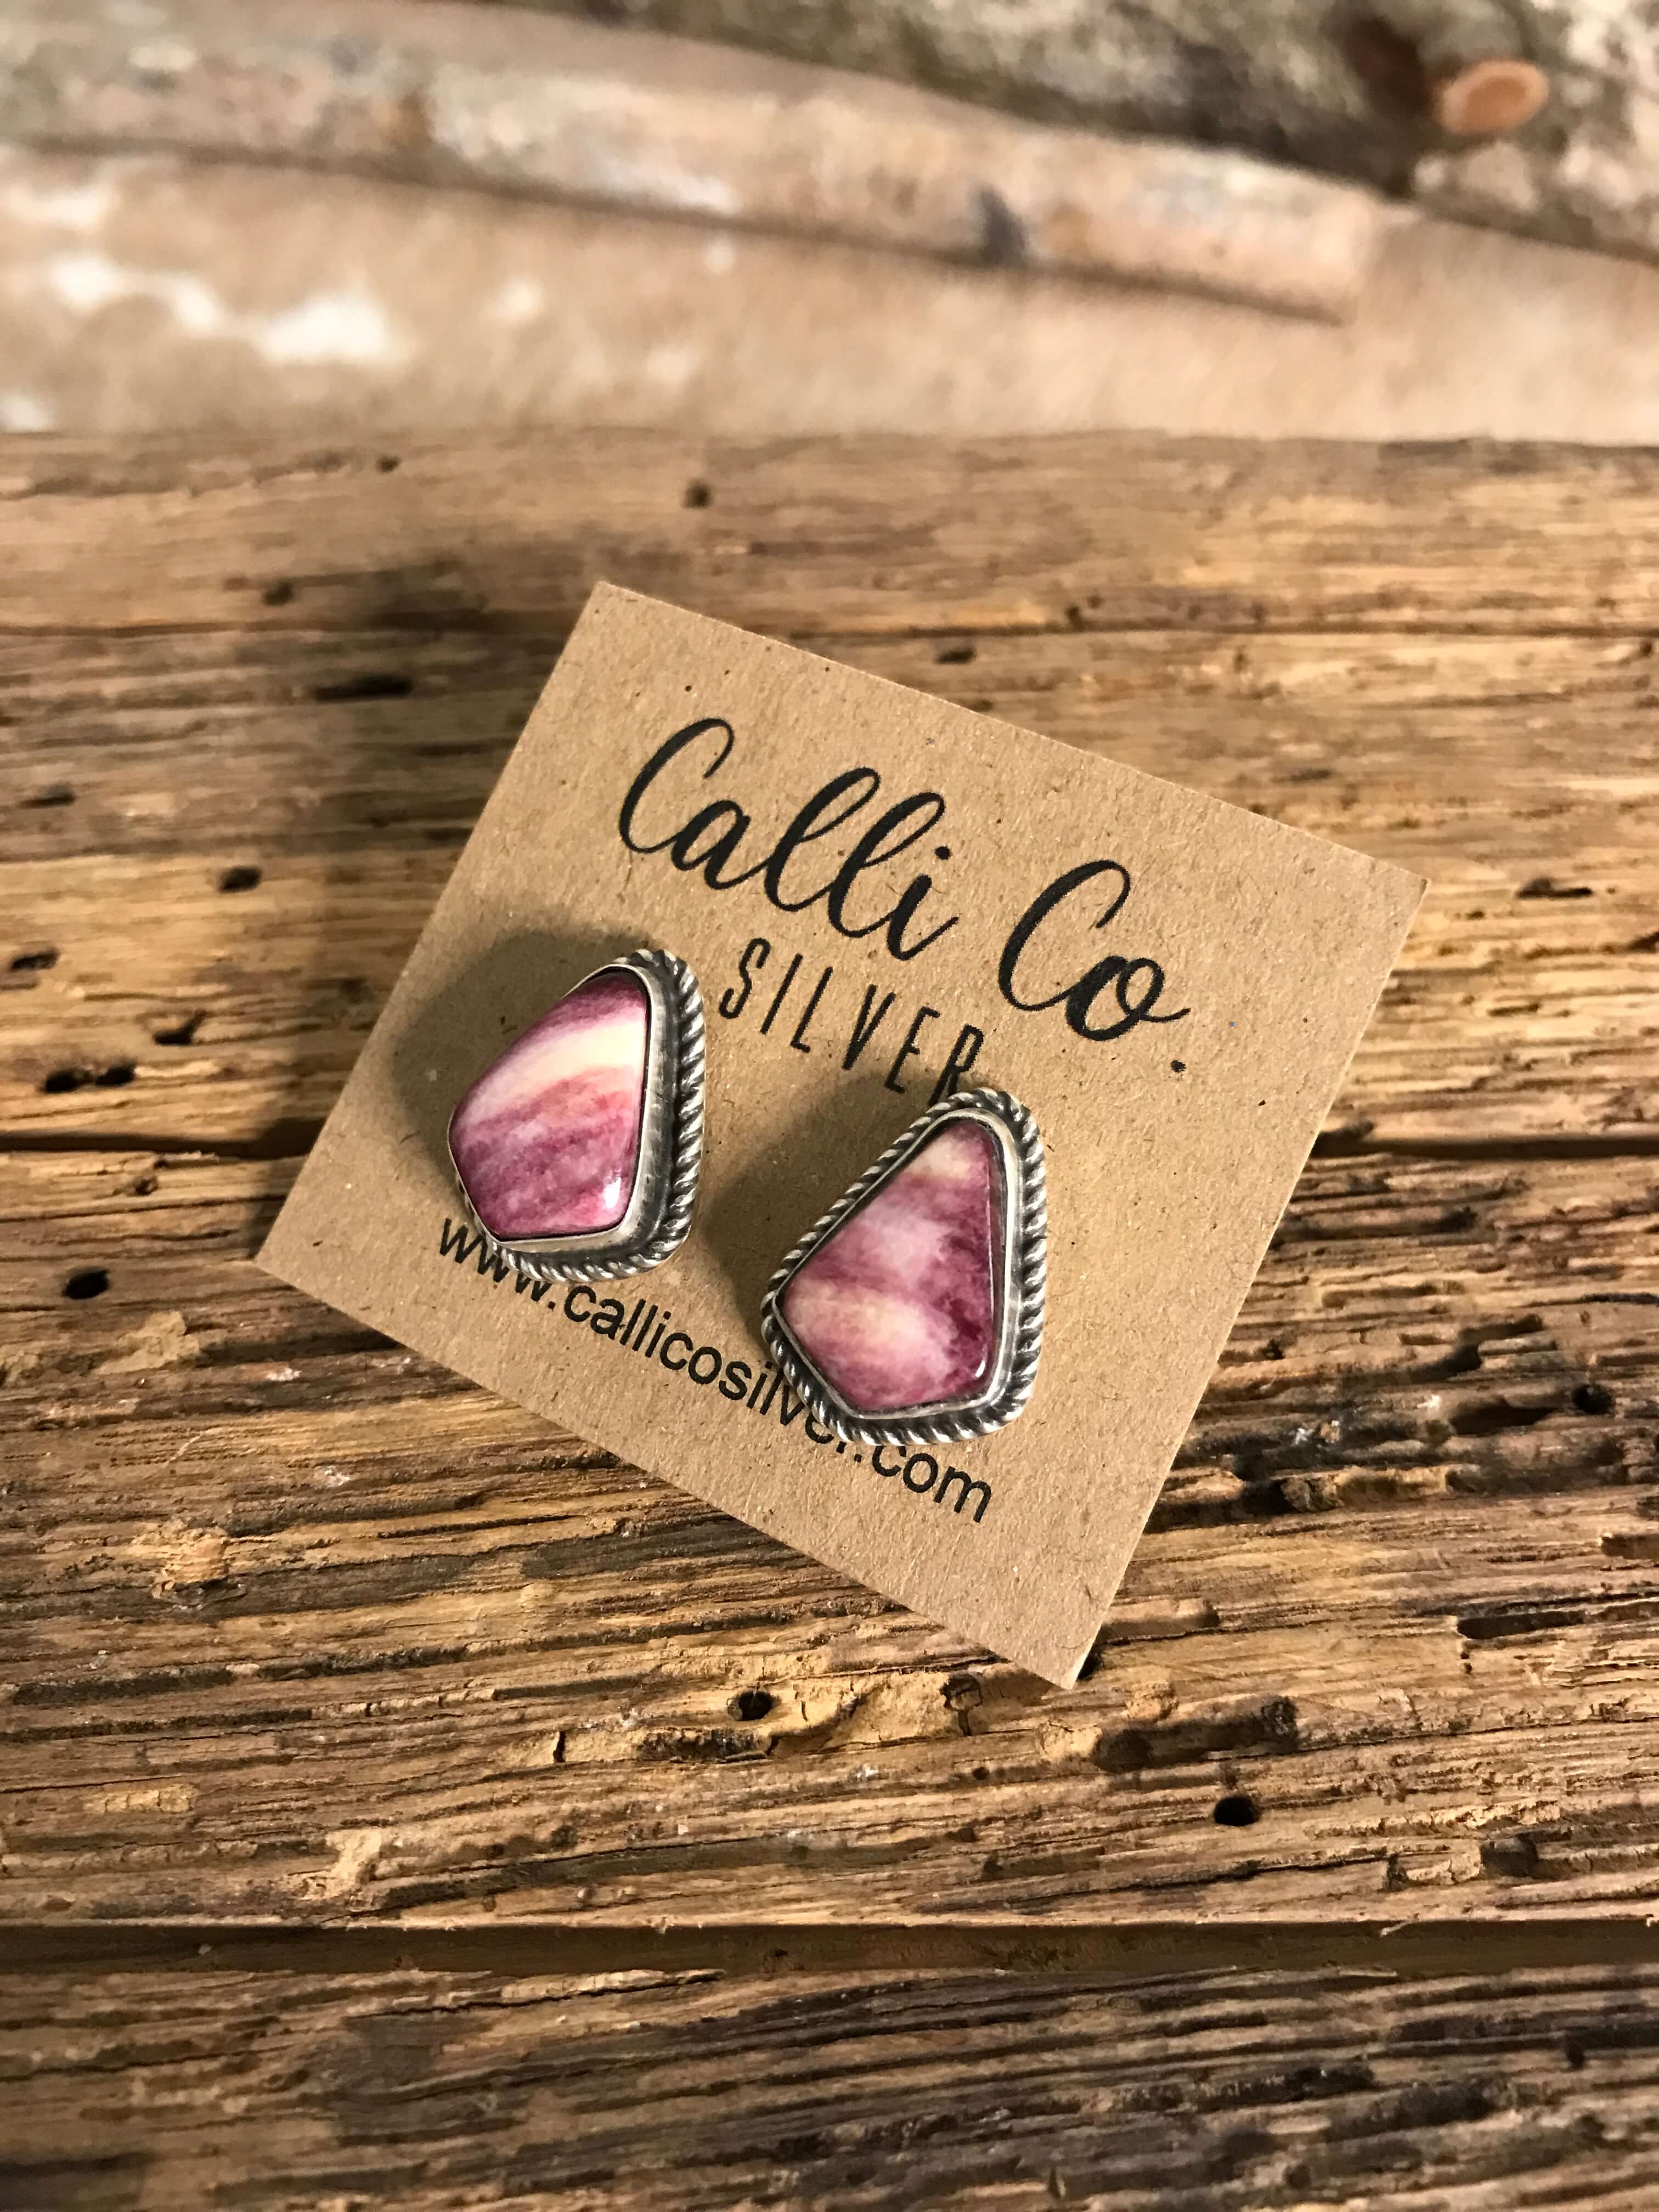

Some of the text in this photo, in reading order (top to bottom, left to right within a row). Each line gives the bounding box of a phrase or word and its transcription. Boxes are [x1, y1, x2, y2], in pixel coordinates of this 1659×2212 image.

[618, 717, 1190, 1072] Calli Co.
[719, 937, 984, 1107] SILVER
[439, 1217, 992, 1523] www.callicosilve.com
